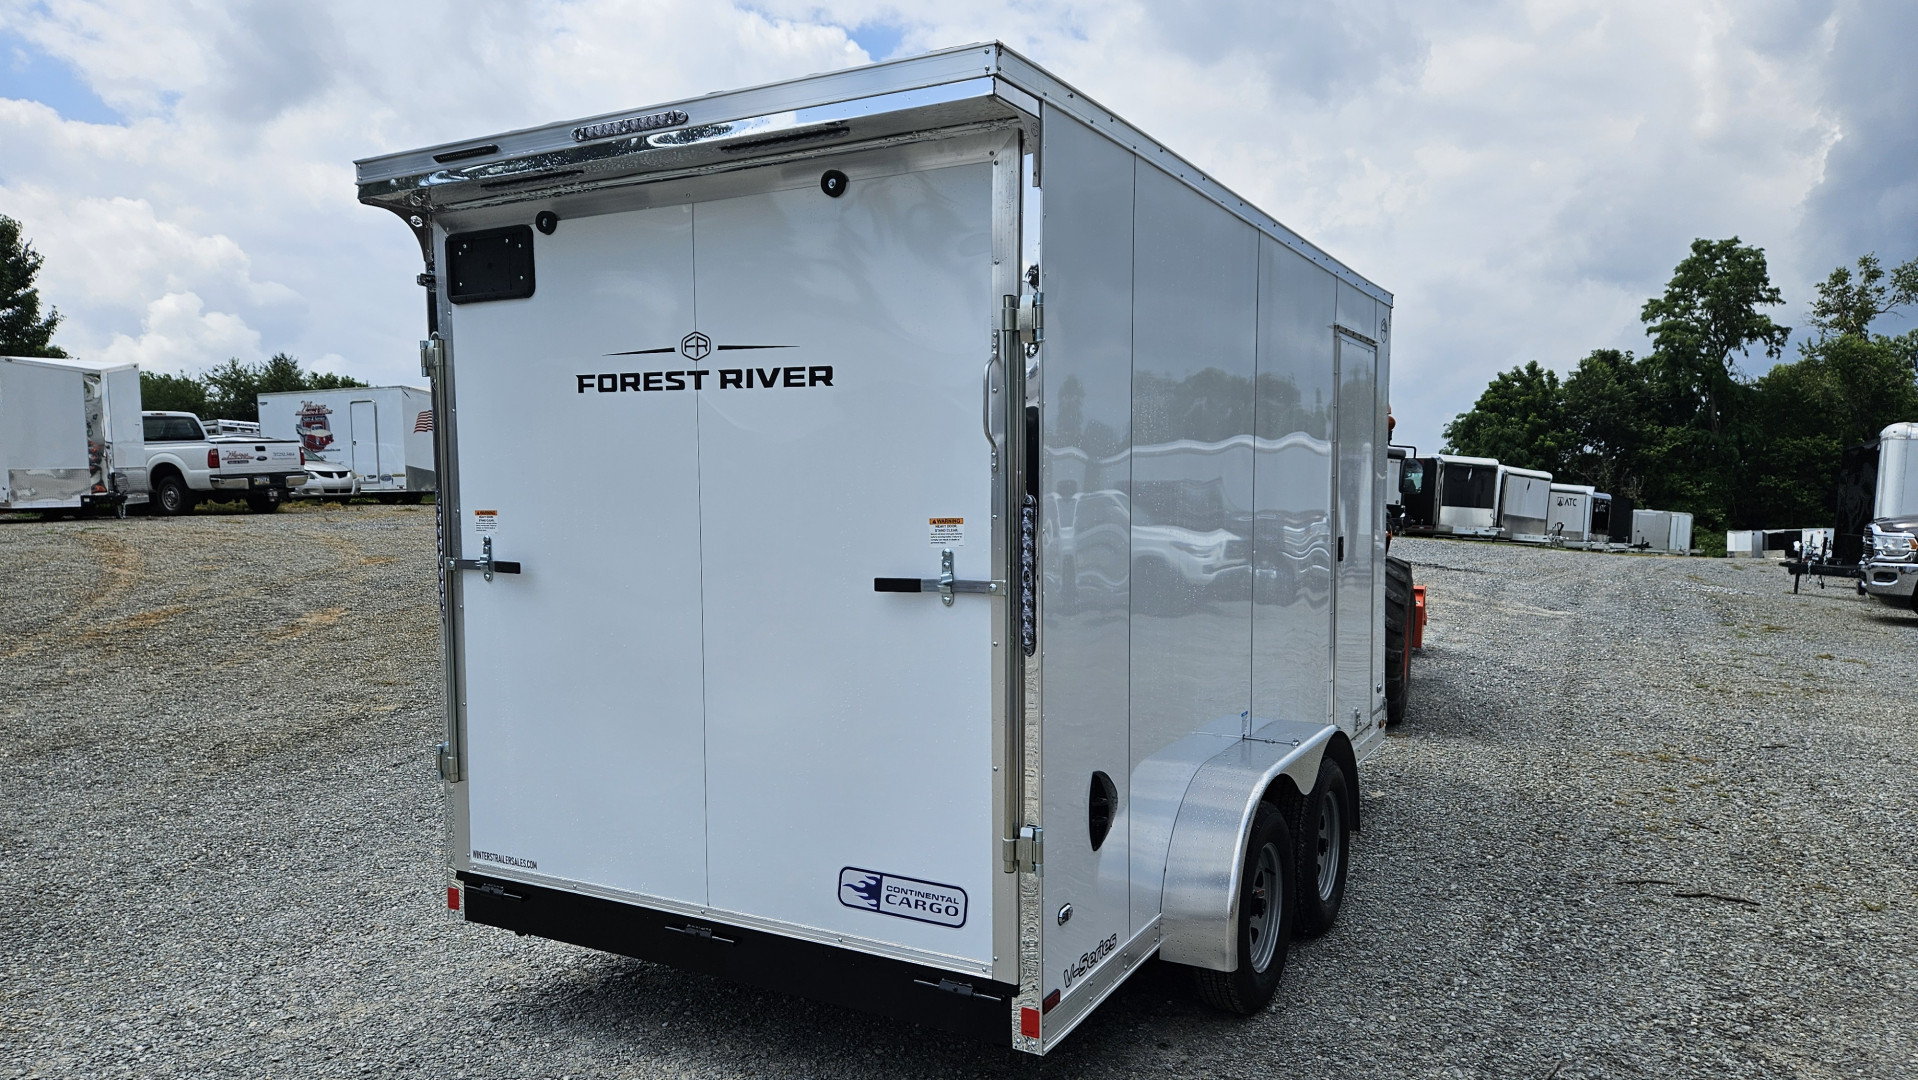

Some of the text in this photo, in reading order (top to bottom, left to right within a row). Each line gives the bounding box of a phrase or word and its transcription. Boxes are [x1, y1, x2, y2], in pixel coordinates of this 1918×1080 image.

[575, 365, 835, 394] FOREST RIVER
[1564, 498, 1577, 507] ATC
[472, 850, 538, 870] WINTERSTRAILERSALES.COM
[885, 894, 959, 917] CARGO
[886, 885, 960, 905] CONTINENTAL
[1063, 932, 1117, 988] V-Series
